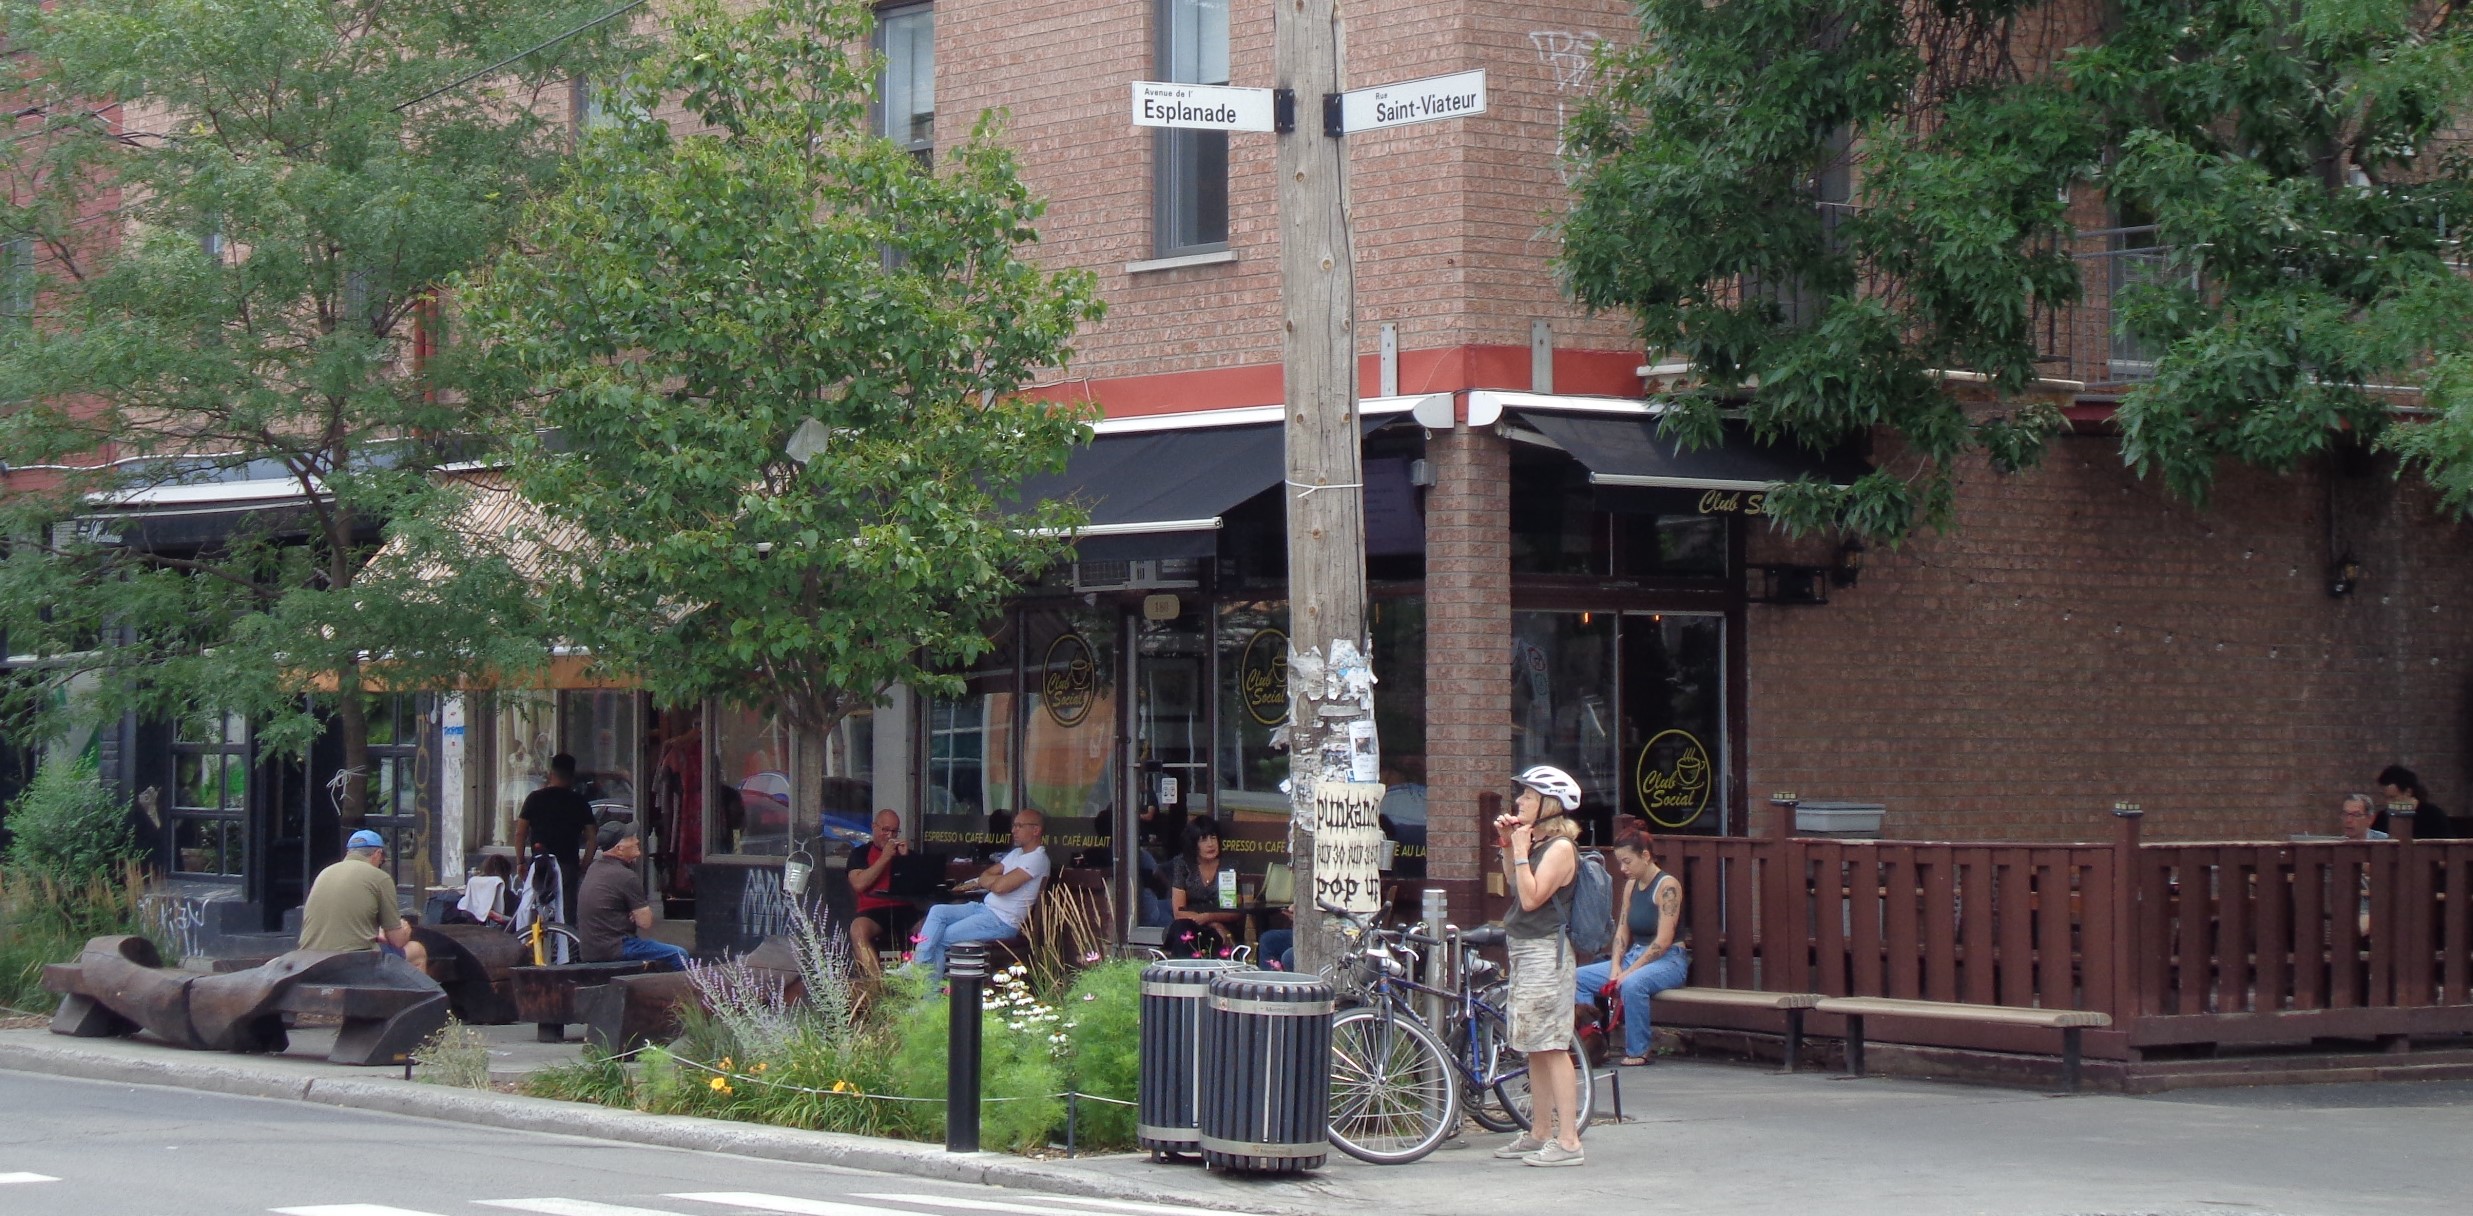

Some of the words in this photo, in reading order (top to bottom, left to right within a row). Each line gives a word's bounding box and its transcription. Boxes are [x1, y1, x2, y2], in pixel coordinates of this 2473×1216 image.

[1144, 88, 1172, 97] Avenue
[1175, 89, 1185, 98] de
[1375, 92, 1388, 100] Rue
[1144, 98, 1237, 124] Esplanade
[1376, 92, 1477, 123] Saint-Viateur
[1698, 489, 1742, 514] Club
[1047, 672, 1072, 695] Club
[1246, 668, 1274, 692] Club
[1052, 689, 1085, 708] Social
[1251, 687, 1285, 706] Social
[1643, 770, 1678, 794] Club
[1650, 789, 1695, 808] Social
[1316, 790, 1380, 835] punkand
[923, 830, 958, 843] ESPRESSO
[984, 832, 995, 844] AU
[995, 833, 1012, 844] LAIT
[1062, 833, 1081, 847] CAFÉ
[1082, 835, 1093, 847] AU
[1094, 836, 1111, 848] LAIT
[1221, 839, 1256, 852] SPRESSO
[1401, 844, 1414, 857] AU
[1415, 844, 1427, 857] LA
[1315, 872, 1361, 907] pop
